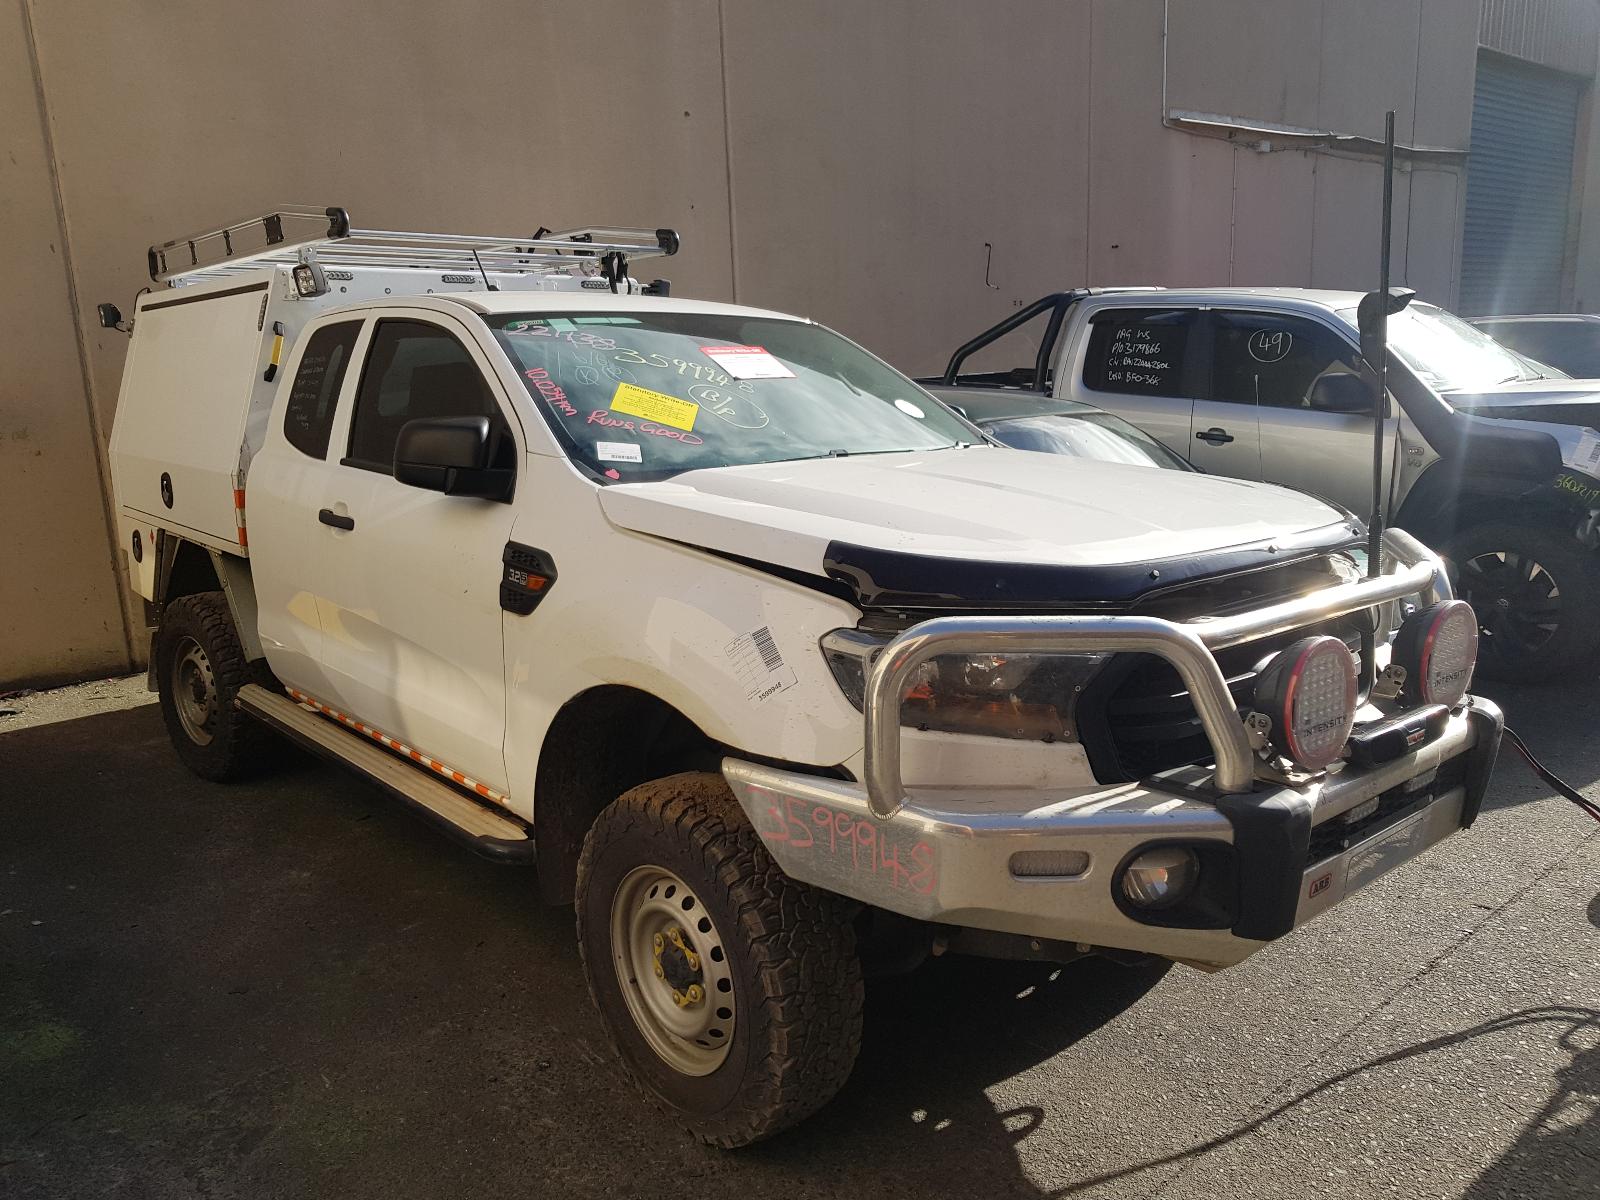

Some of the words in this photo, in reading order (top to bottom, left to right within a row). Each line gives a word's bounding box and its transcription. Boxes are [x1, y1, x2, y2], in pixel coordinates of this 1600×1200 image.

[1259, 332, 1283, 354] 49
[640, 422, 704, 445] GOOD
[746, 784, 938, 896] 3599948
